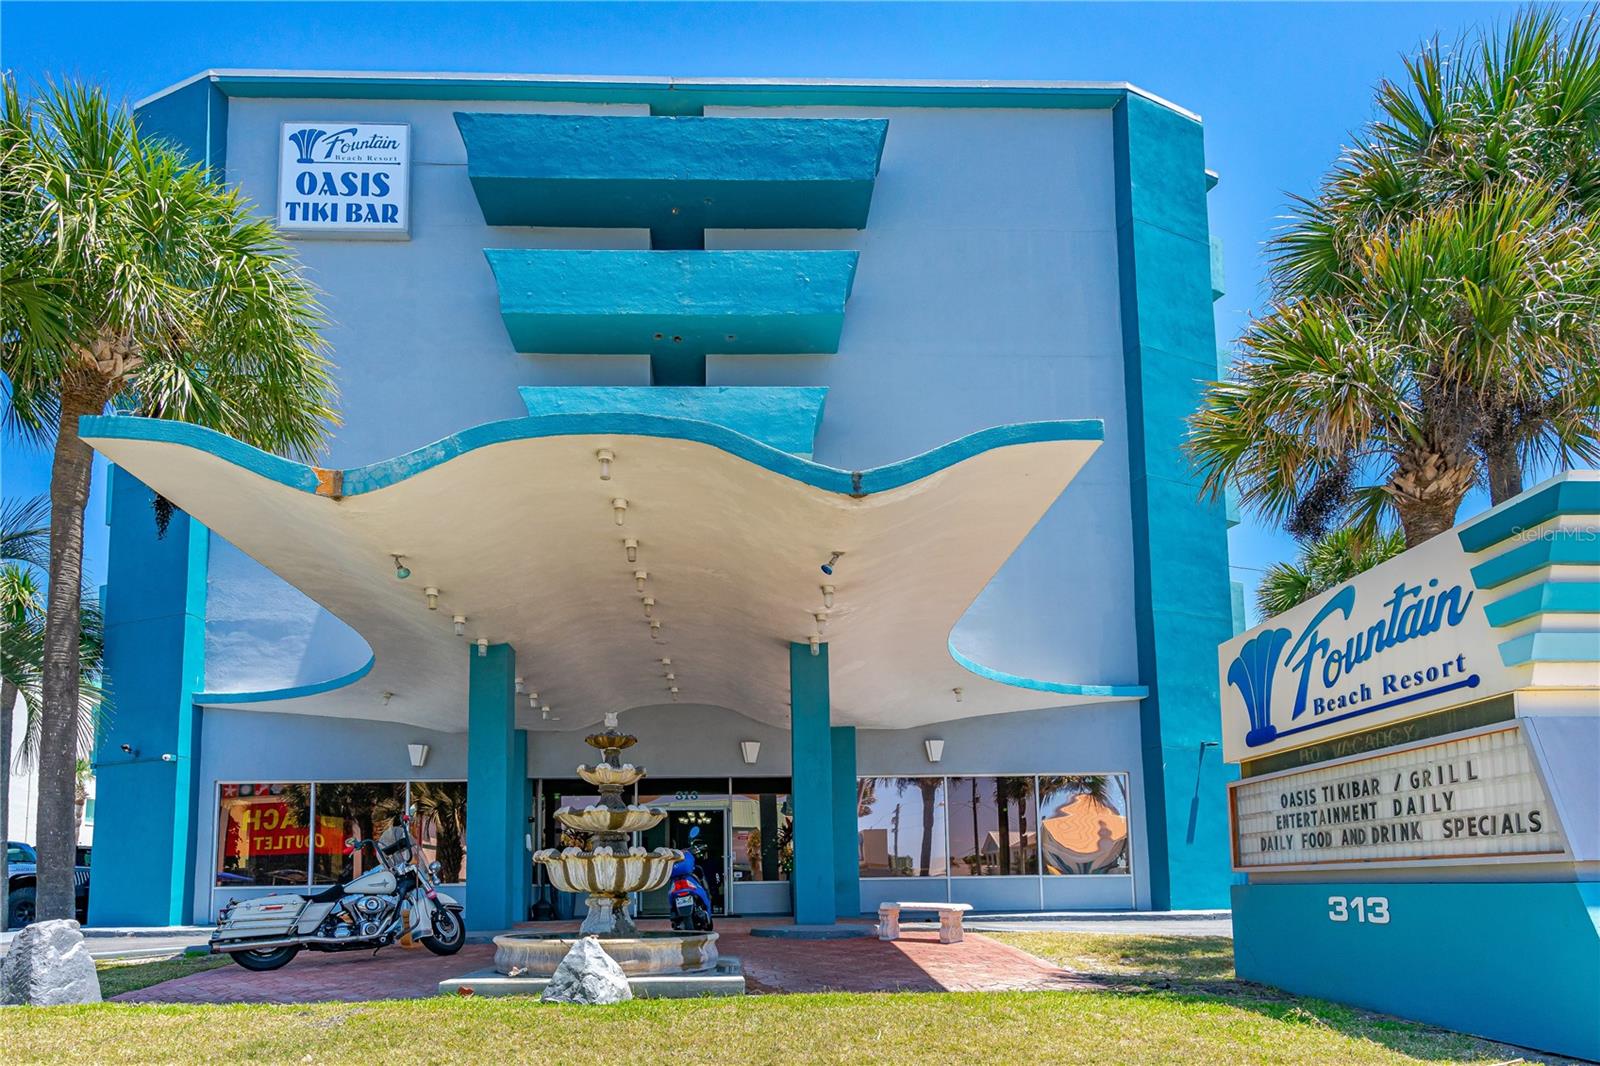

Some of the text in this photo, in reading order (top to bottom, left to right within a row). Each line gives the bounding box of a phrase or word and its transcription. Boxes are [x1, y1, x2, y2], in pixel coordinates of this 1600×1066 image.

[322, 128, 400, 159] Fountain
[296, 171, 390, 197] OASIS
[285, 202, 398, 223] TIKI BAR
[1284, 578, 1474, 721] Fountain
[1313, 653, 1466, 716] Beach Resort
[675, 791, 698, 800] 313
[1281, 789, 1316, 808] OASIS
[1276, 791, 1453, 830] ENTERTAINMENT DAILY
[1260, 810, 1542, 851] DAILY FOOD AND DRINK SPECIALS
[1328, 896, 1390, 924] 313
